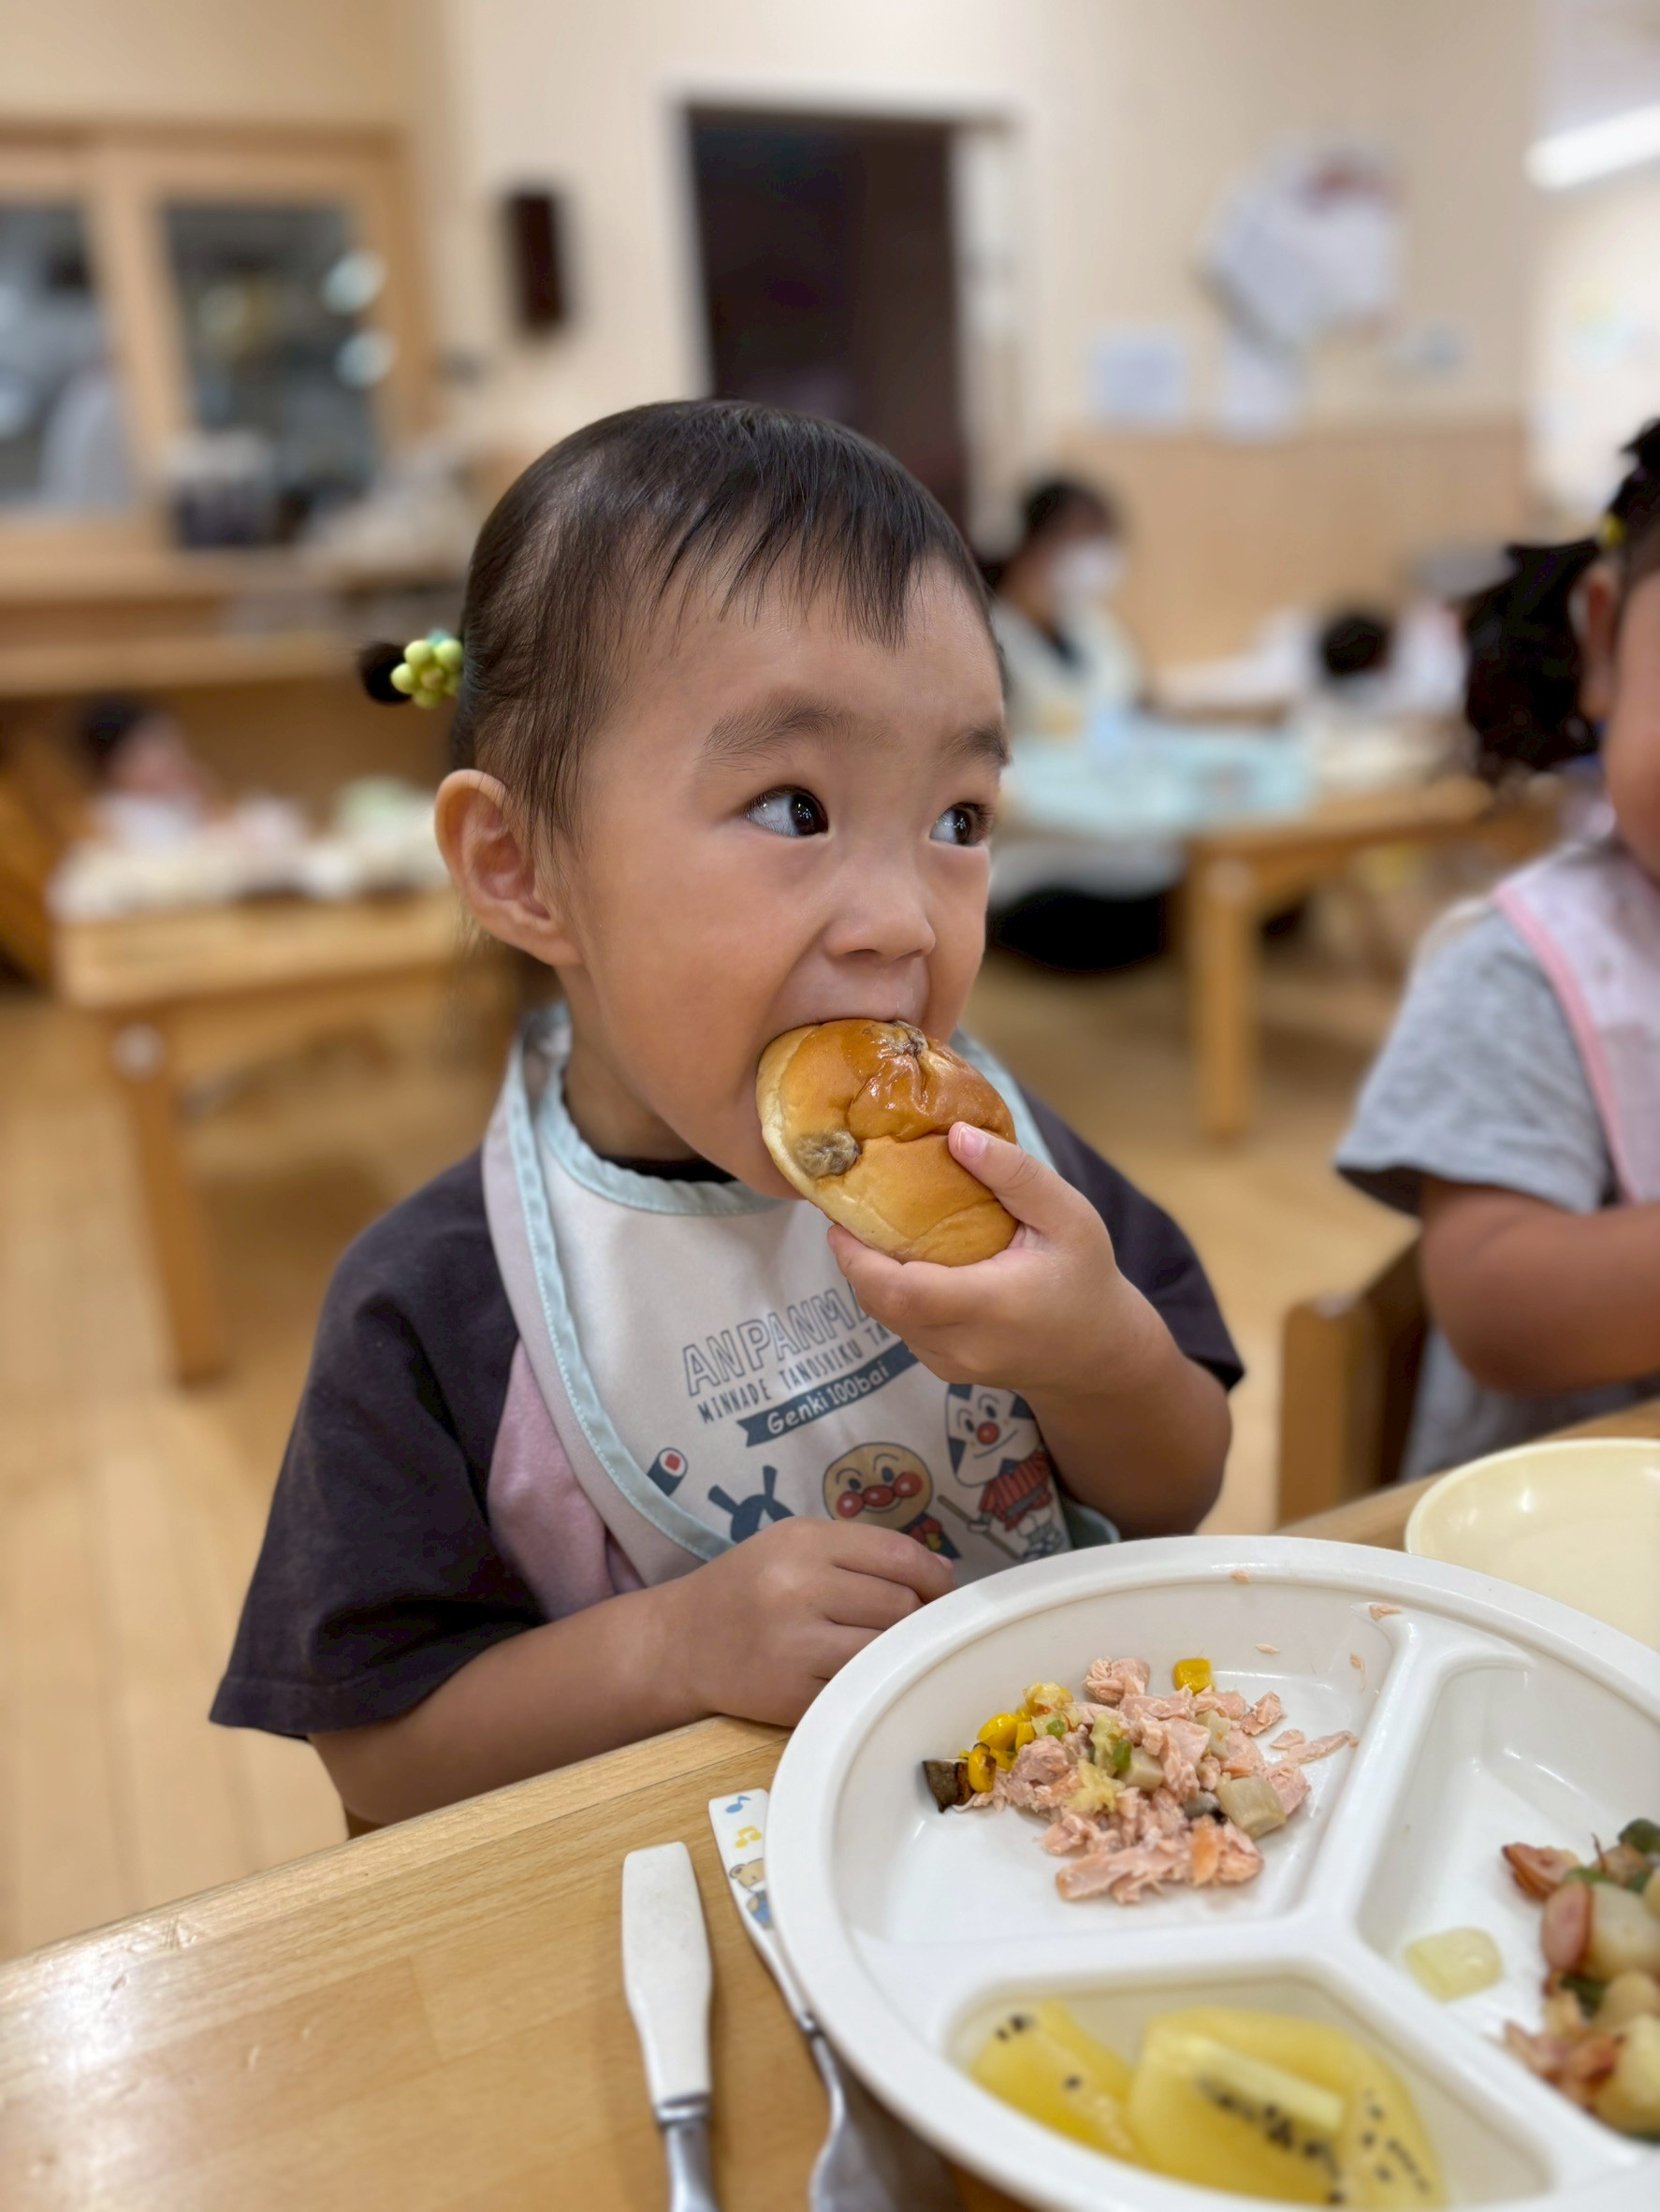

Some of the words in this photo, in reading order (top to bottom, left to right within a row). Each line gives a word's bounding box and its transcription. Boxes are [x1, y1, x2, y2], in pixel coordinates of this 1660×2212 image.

[697, 1377, 772, 1424] MINNADE
[778, 1338, 863, 1390] TANOSHIKU
[767, 1391, 829, 1433] Genki
[827, 1360, 889, 1404] 100bai
